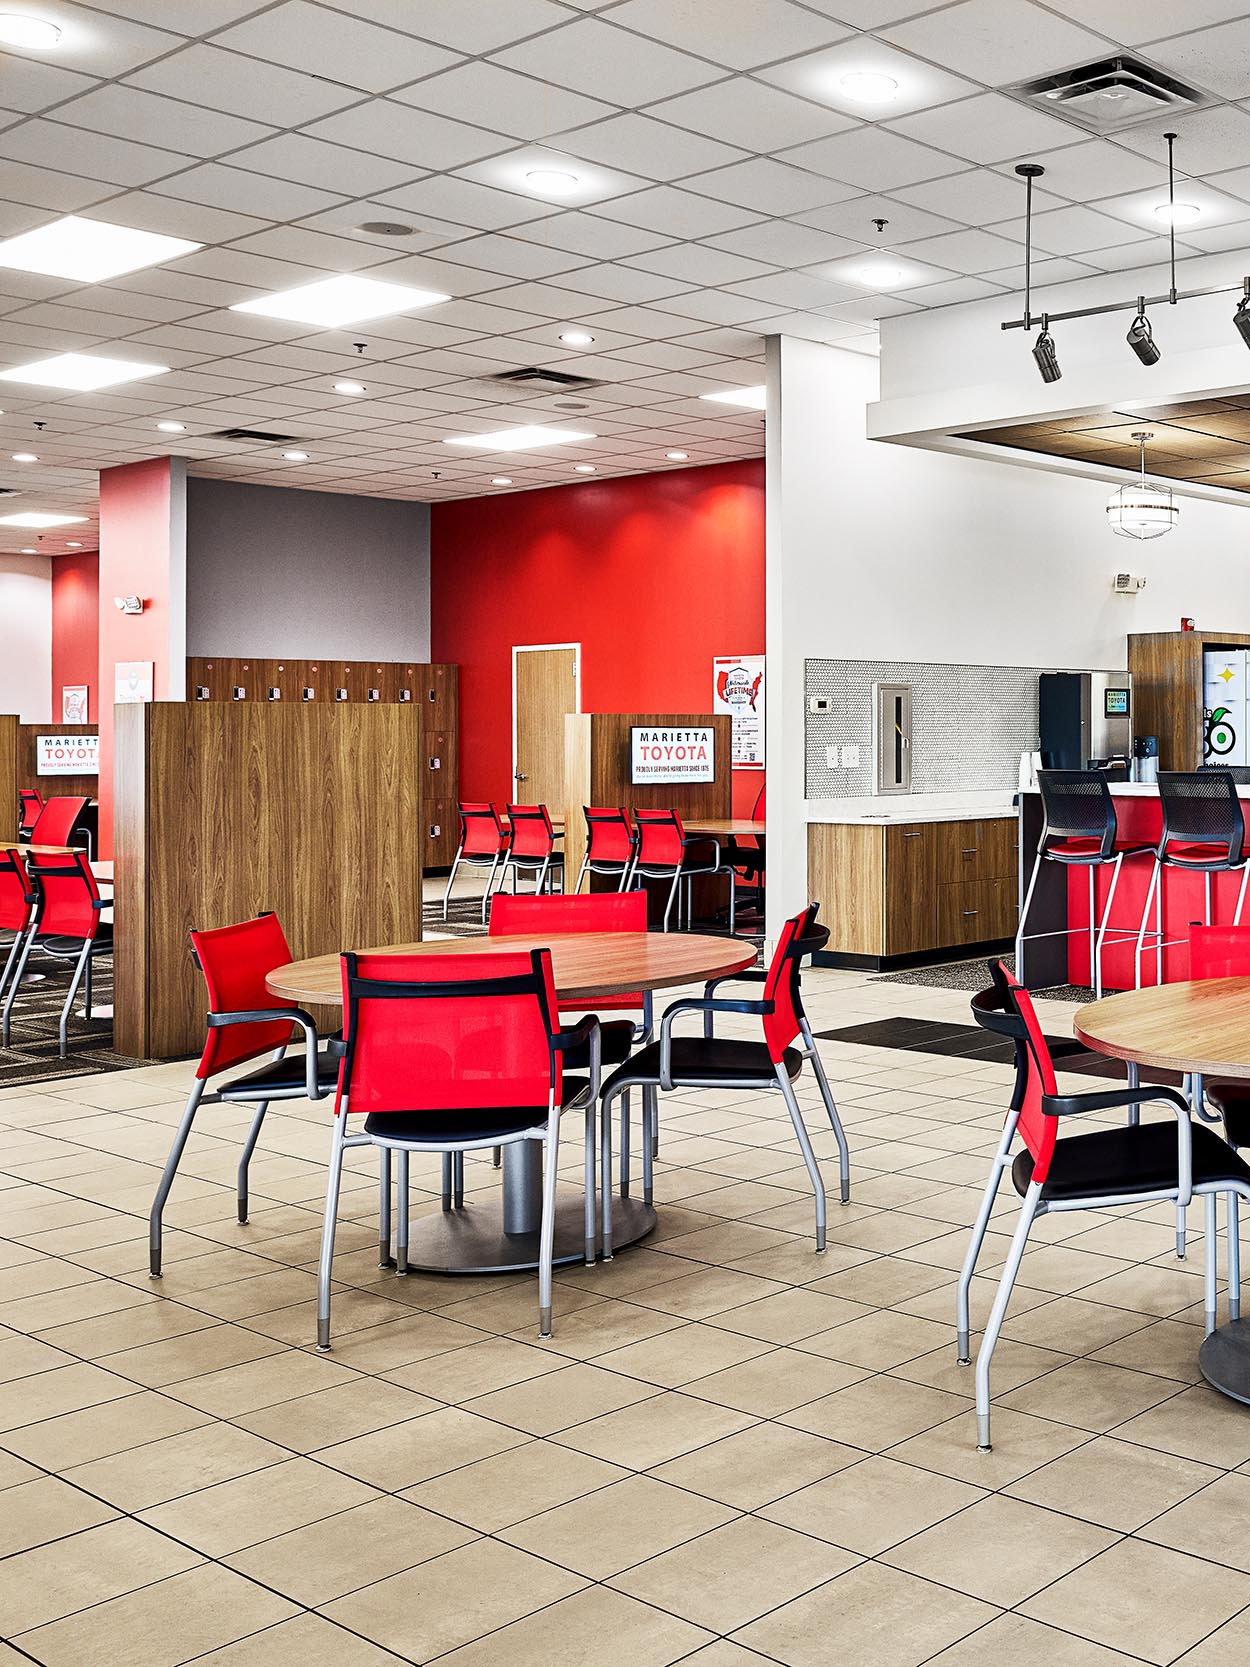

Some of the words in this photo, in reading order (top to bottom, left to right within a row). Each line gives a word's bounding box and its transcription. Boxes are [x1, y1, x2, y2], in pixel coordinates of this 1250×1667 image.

[725, 687, 754, 697] LIFETIME
[44, 738, 98, 746] MARIETT
[640, 732, 708, 742] MARIETTA
[45, 748, 97, 759] TOYOT
[640, 745, 707, 761] TOYOTA
